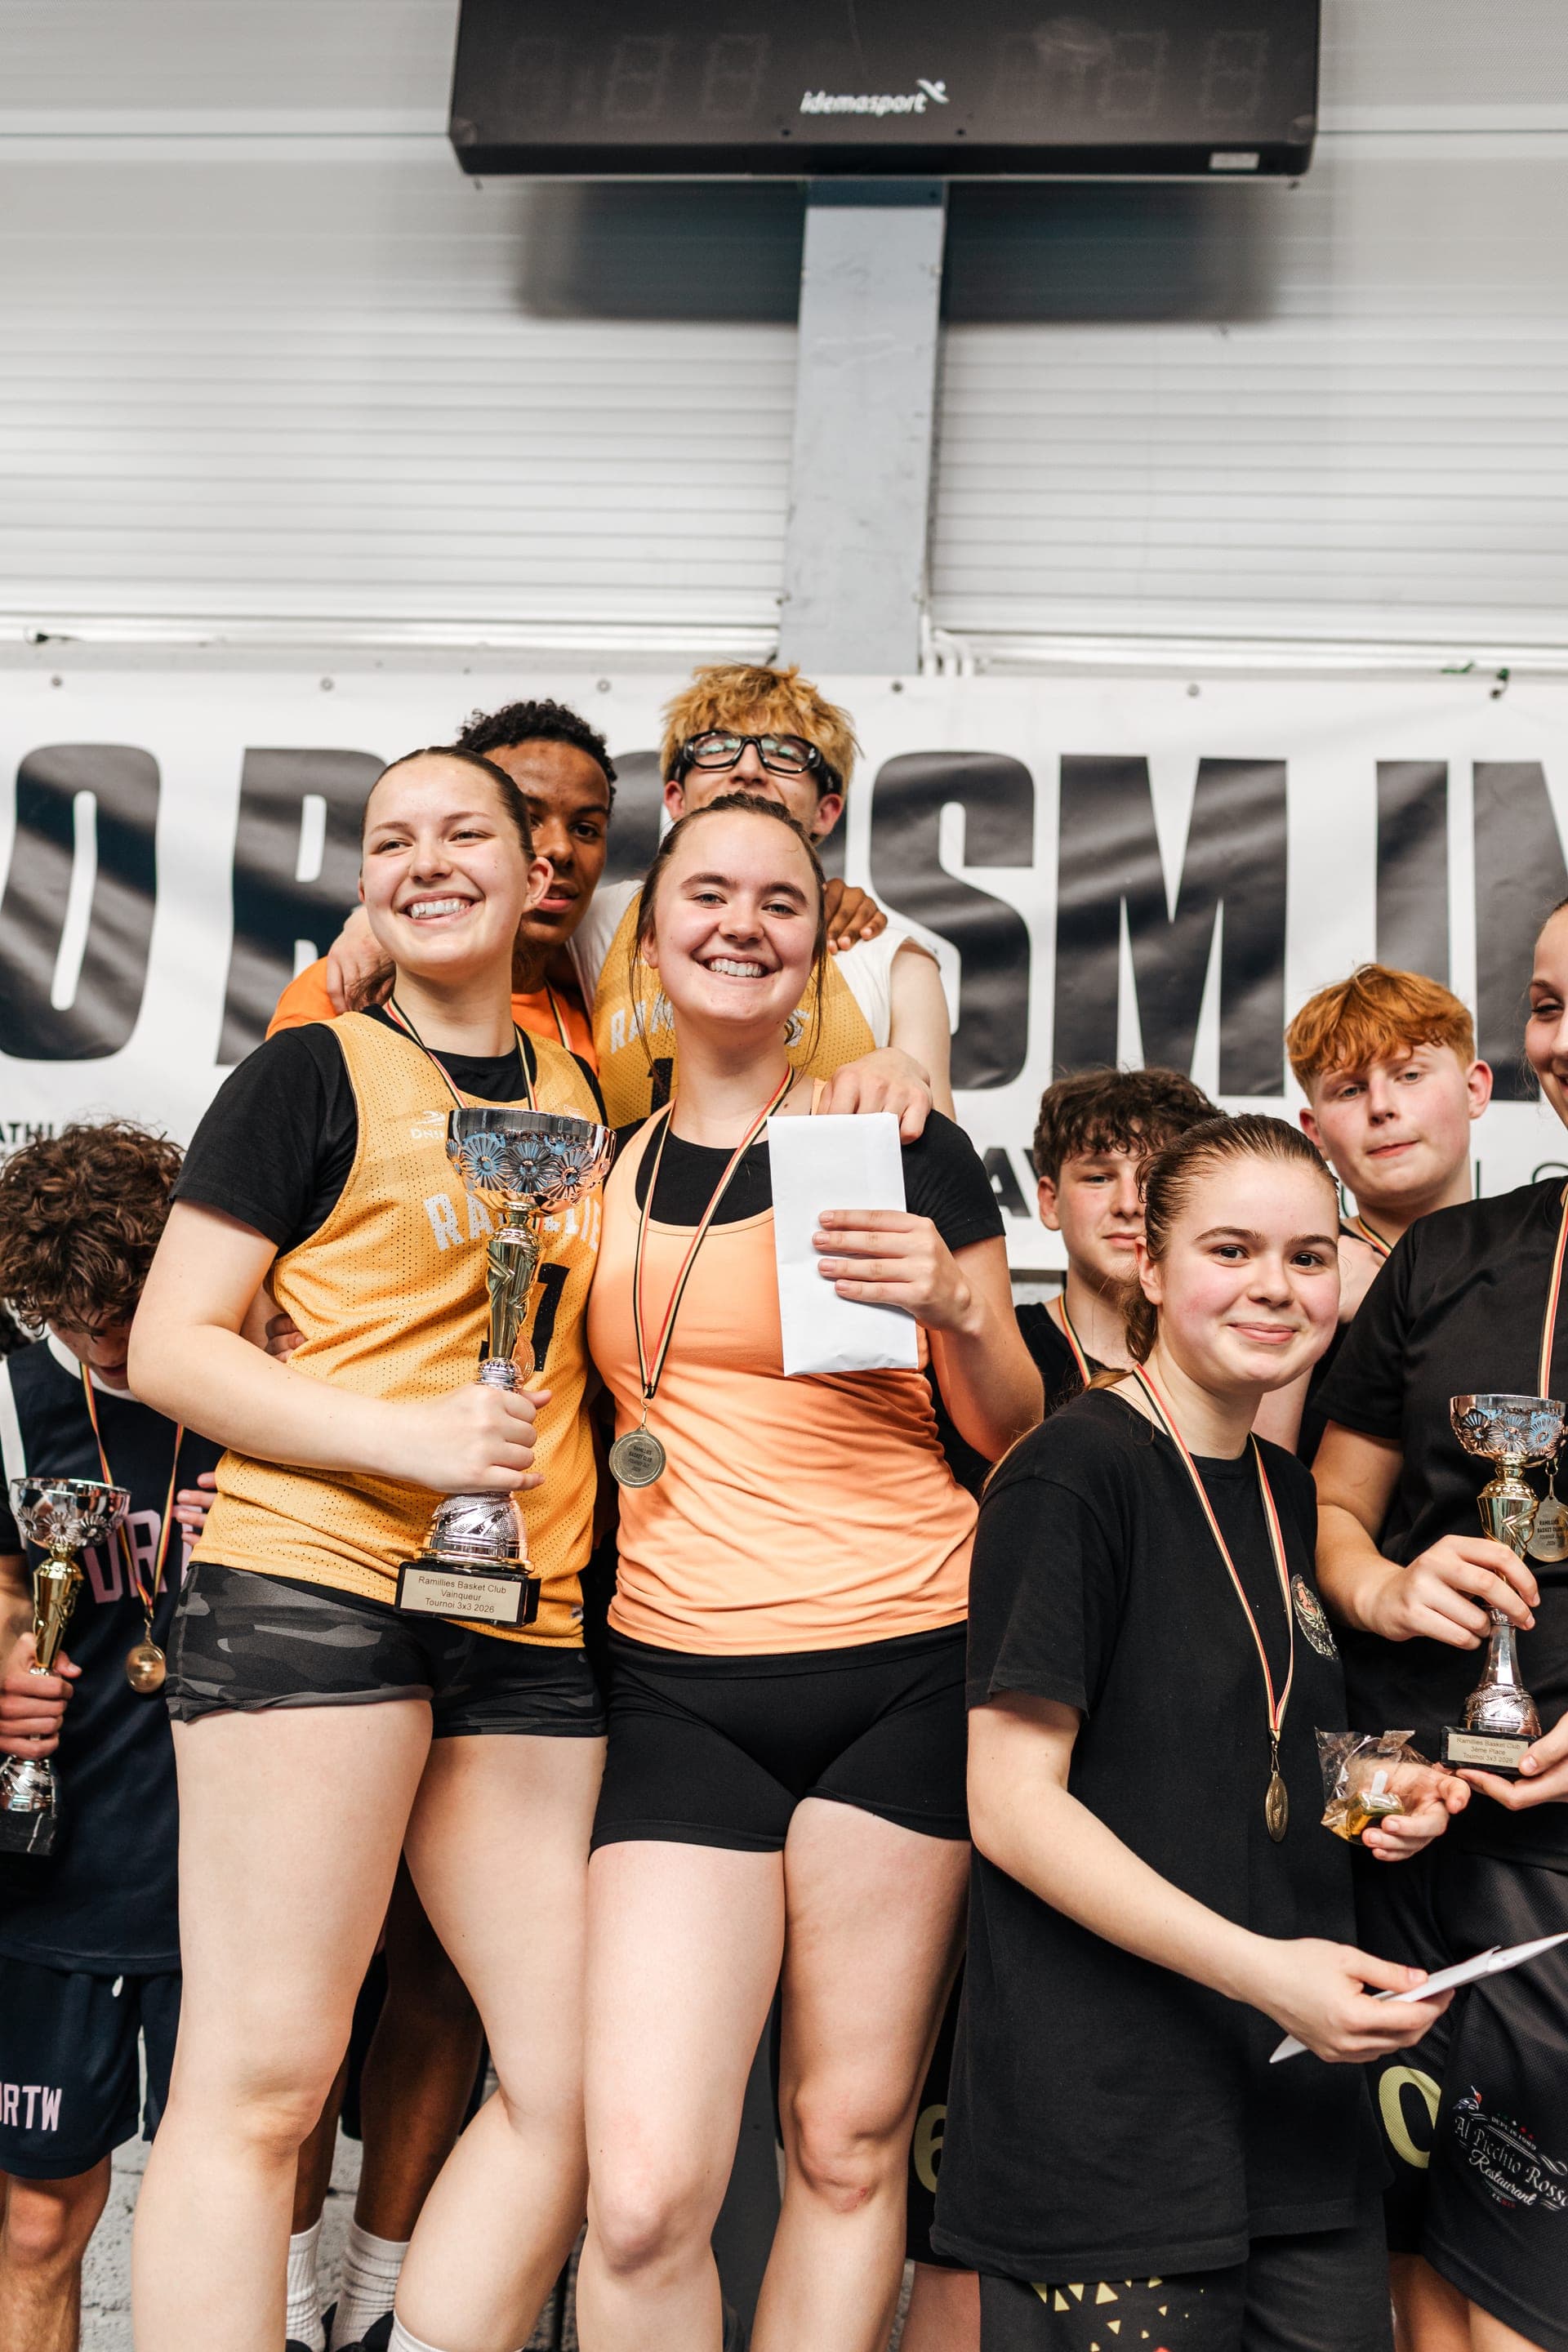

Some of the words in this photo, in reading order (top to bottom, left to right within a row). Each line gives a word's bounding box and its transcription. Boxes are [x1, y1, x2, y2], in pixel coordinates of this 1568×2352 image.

[800, 90, 928, 117] idemasport
[418, 1575, 455, 1588] Ramillies
[457, 1580, 485, 1591] Basket
[488, 1584, 506, 1594] Club
[441, 1589, 481, 1601] Vainqueur
[425, 1598, 455, 1609] Tournoi
[457, 1601, 472, 1610] 3x3
[474, 1602, 495, 1614] 2026
[0, 2082, 63, 2132] RTW
[1468, 2149, 1538, 2206] Restaurant
